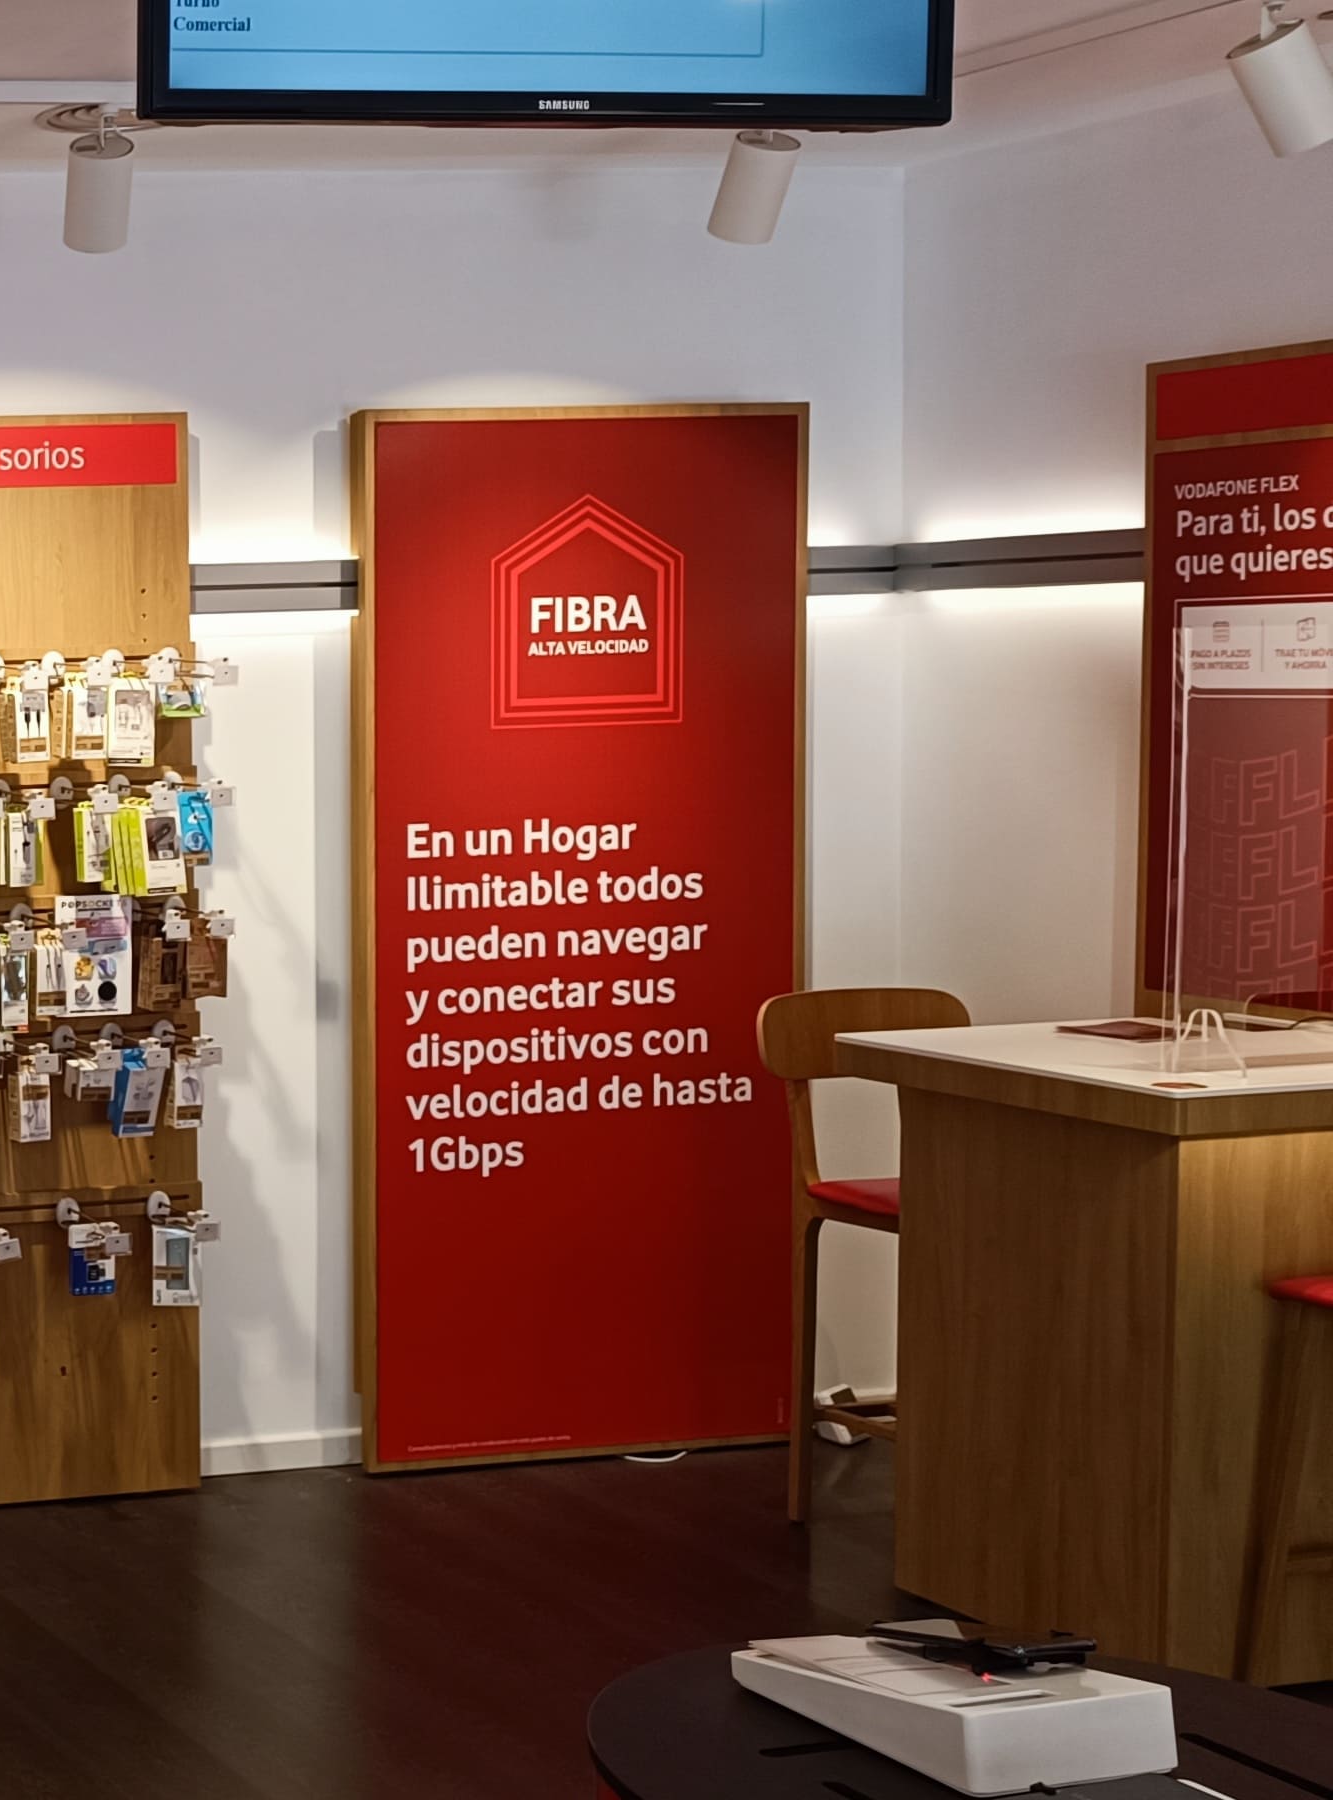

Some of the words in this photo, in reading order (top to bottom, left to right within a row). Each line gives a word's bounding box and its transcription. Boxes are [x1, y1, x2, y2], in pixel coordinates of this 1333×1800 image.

[173, 16, 252, 32] Comercial
[538, 99, 590, 110] SAMSUNG
[1174, 477, 1258, 500] VODAFONE
[1260, 474, 1300, 493] FLEX
[1176, 510, 1233, 537] Para
[1240, 504, 1267, 536] ti,
[1273, 502, 1317, 531] los
[1175, 553, 1224, 583] que
[1230, 543, 1333, 580] quieres
[530, 594, 648, 634] FIBRA
[527, 640, 566, 656] ALTA
[567, 638, 650, 655] VELOCIDAD
[406, 822, 455, 859] En
[465, 827, 513, 857] un
[523, 818, 638, 861] Hogar
[61, 899, 128, 909] POPSOCK
[406, 869, 589, 912] Ilimitable
[596, 866, 704, 902] todos
[406, 925, 547, 974] pueden
[556, 923, 709, 963] navegar
[405, 988, 430, 1026] y
[436, 977, 604, 1016] conectar
[611, 977, 676, 1007] sus
[405, 1026, 634, 1075] dispositivos
[641, 1027, 709, 1056] con
[405, 1076, 589, 1121] velocidad
[597, 1074, 643, 1110] de
[652, 1071, 753, 1107] hasta
[407, 1135, 525, 1178] 1Gbps
